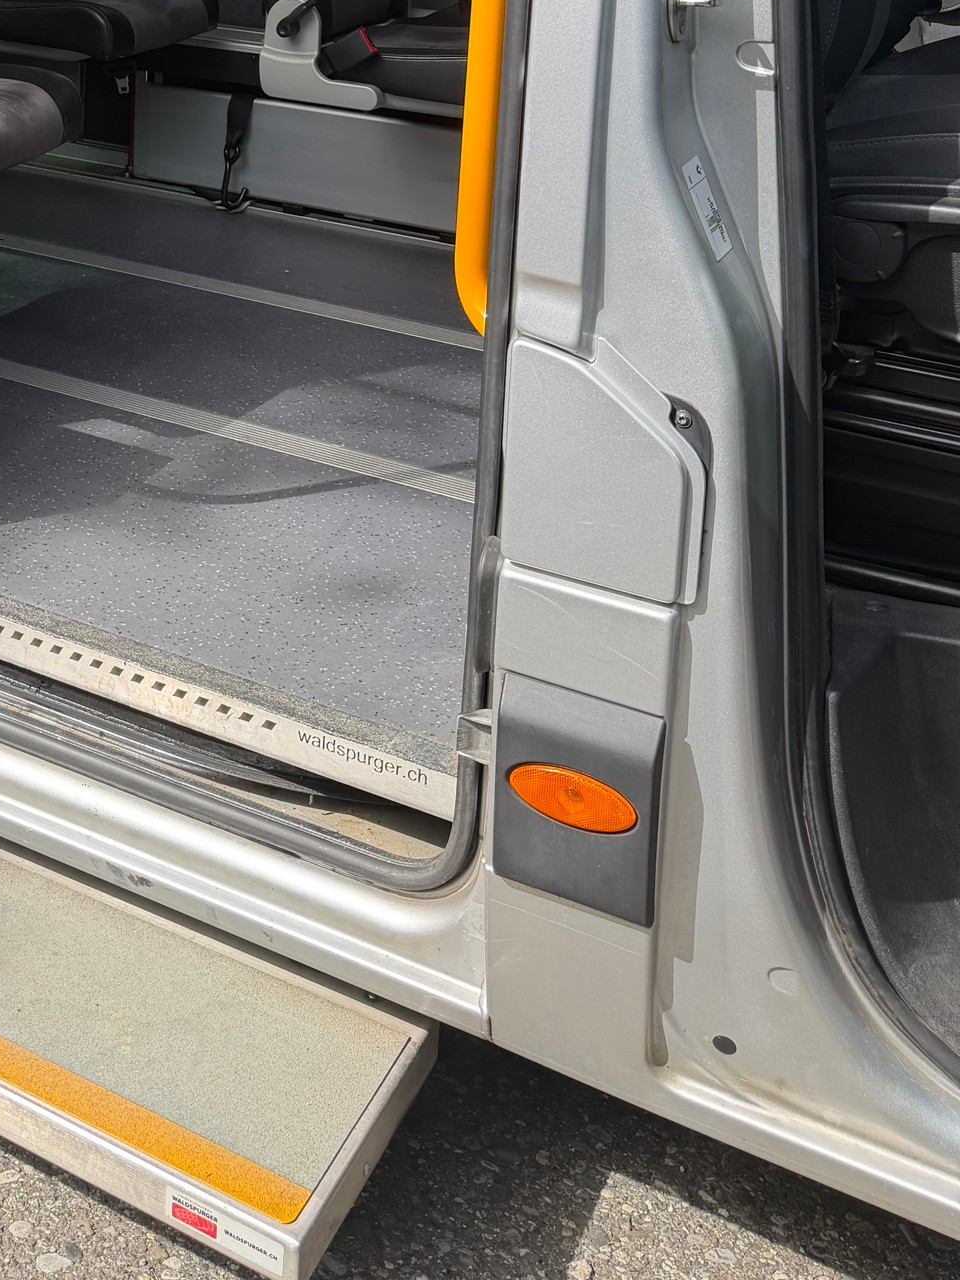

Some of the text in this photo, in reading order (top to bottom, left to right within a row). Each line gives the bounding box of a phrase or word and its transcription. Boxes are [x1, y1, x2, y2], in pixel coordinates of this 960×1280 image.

[297, 730, 428, 786] waldspurger.ch
[171, 1195, 218, 1223] WALDSPURGER
[223, 1229, 278, 1261] WALDSPURGER.CH
